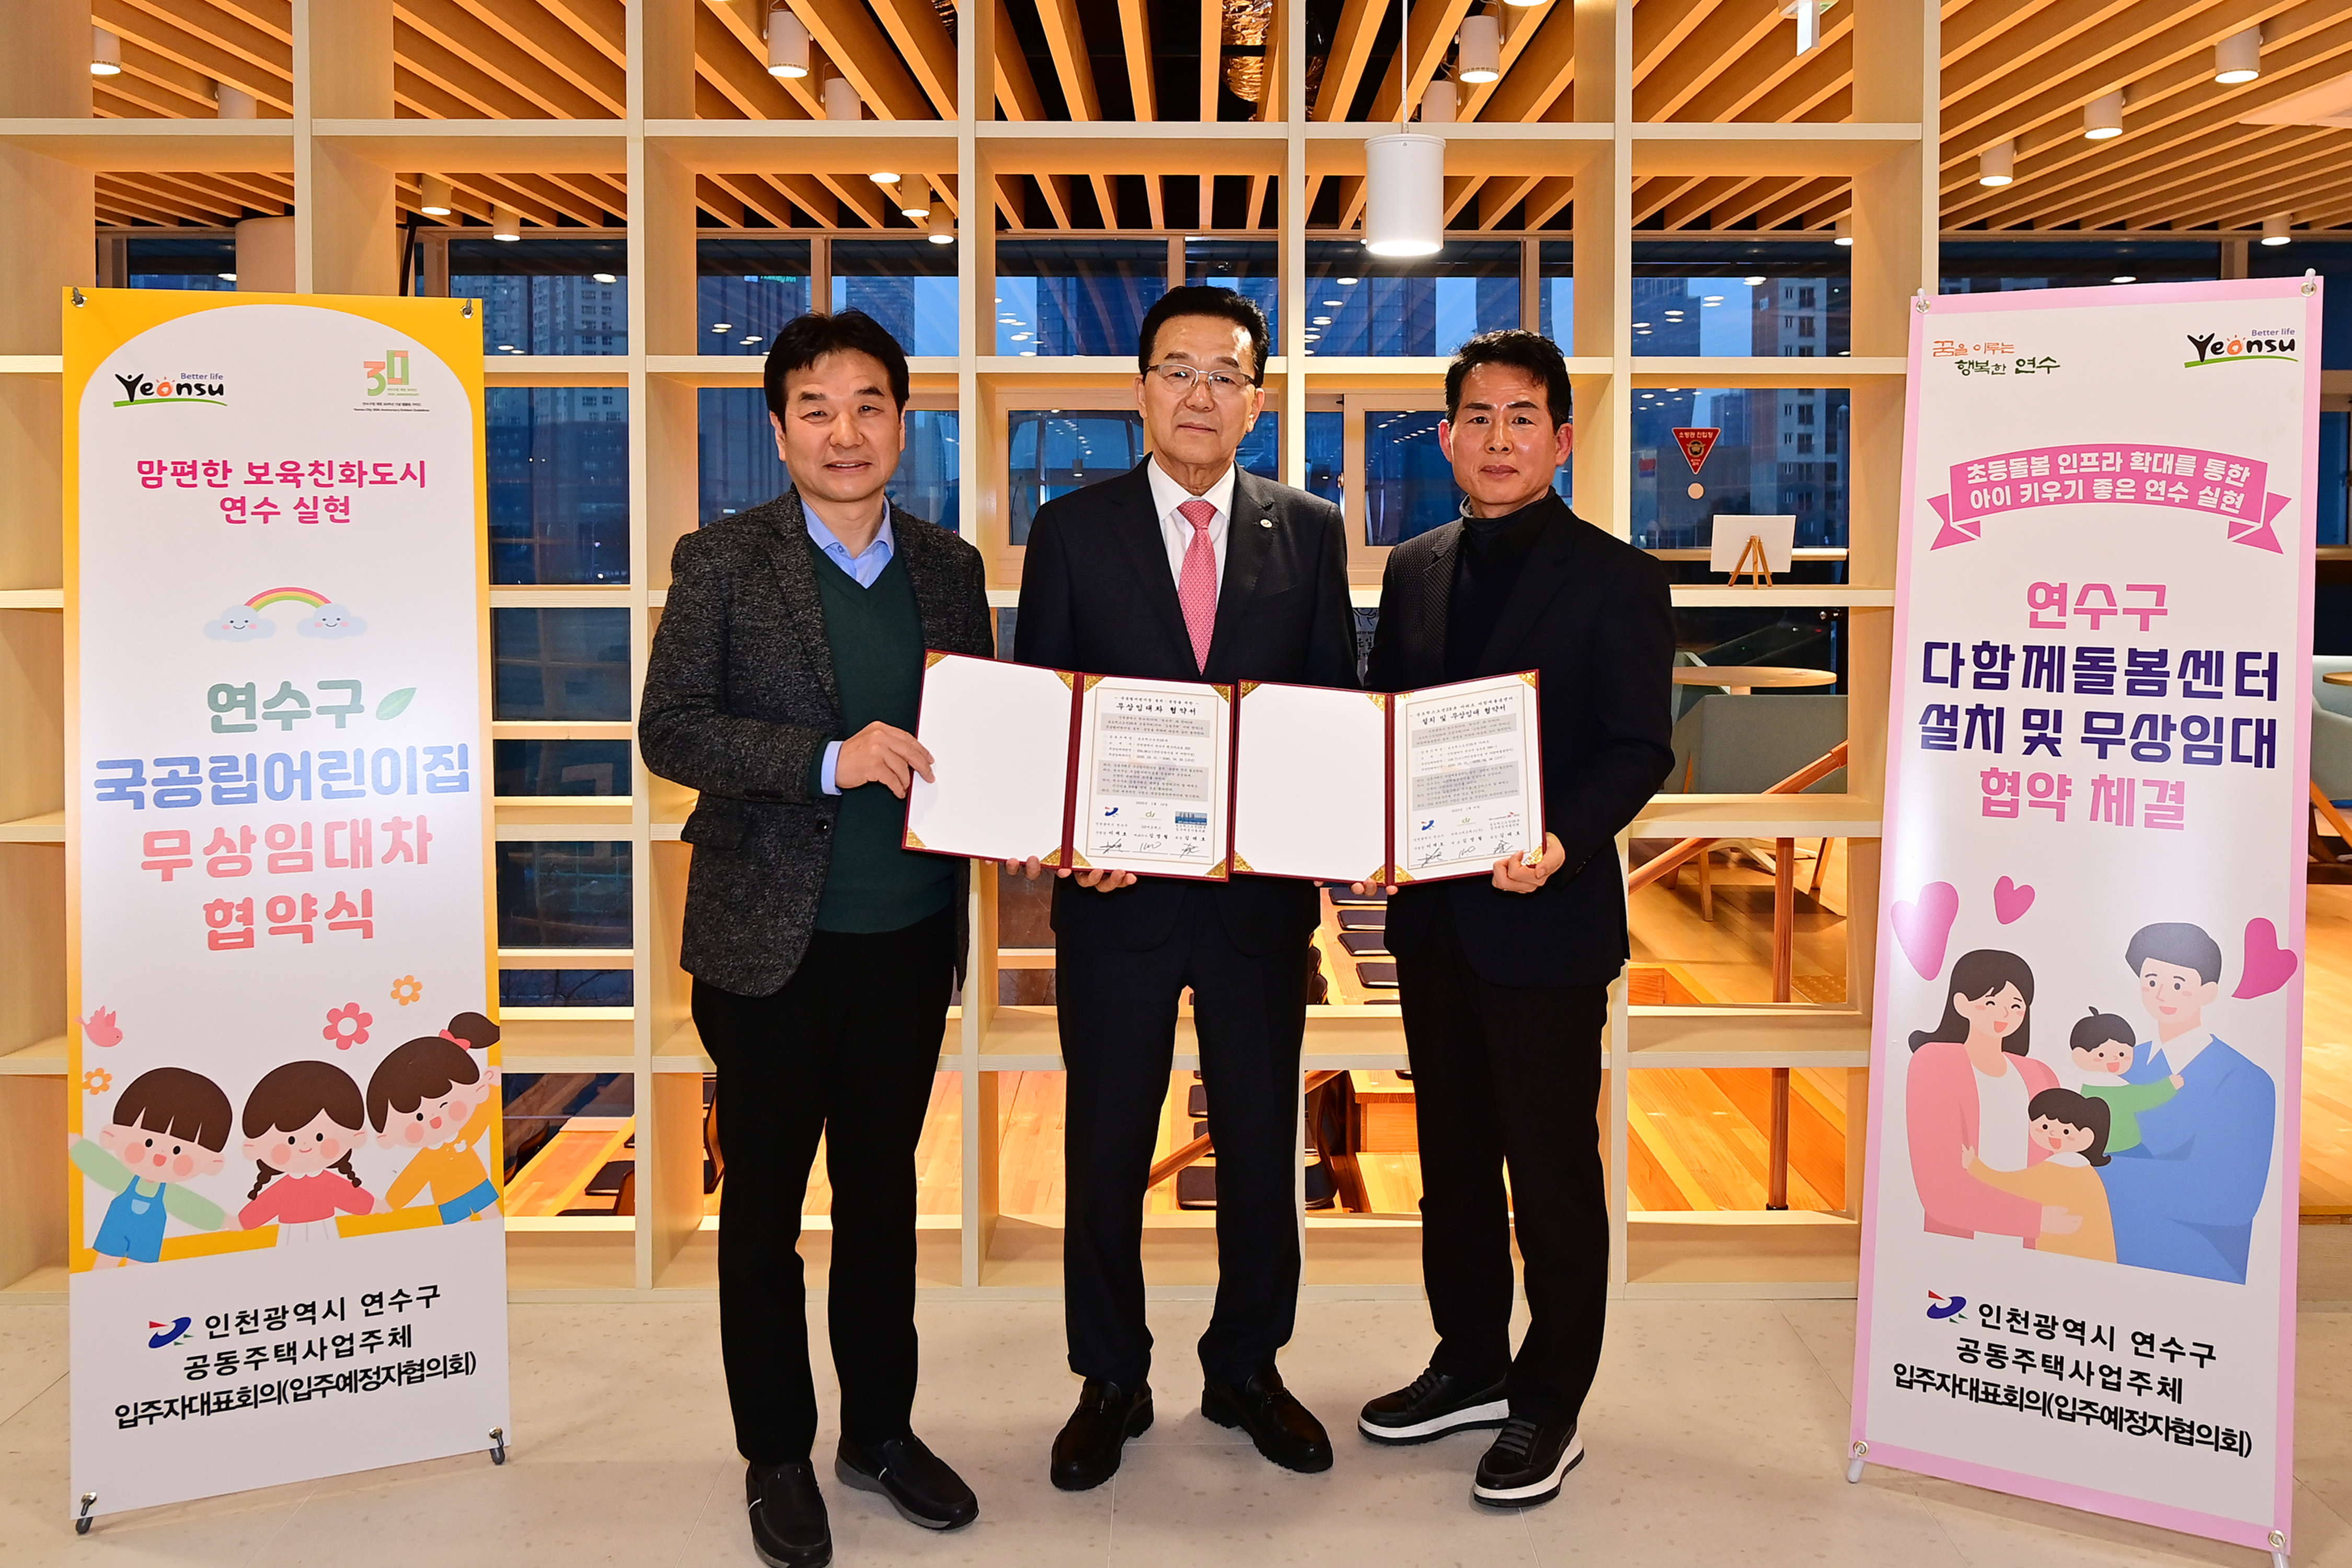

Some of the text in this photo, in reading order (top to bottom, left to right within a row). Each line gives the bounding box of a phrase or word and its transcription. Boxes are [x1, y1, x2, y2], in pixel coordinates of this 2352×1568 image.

[364, 350, 409, 396] 30
[1933, 340, 2014, 358] 꿈을 이루는
[1954, 356, 2060, 376] 행복한 연수
[2187, 332, 2296, 362] Yeonsu
[114, 373, 224, 402] Yeonsu
[137, 460, 426, 489] 맘편한 보육친화도시
[1967, 452, 2251, 488] 초등돌봄 인프라 확대를 통한
[1970, 478, 2245, 515] 아이 키우기 좋은 연수 실현
[220, 495, 350, 524] 연수 실현
[2027, 582, 2168, 631] 연수구
[1922, 640, 2278, 701] 다함께돌봄센터
[207, 679, 365, 733] 연수구
[1918, 703, 2276, 768] 설치 및 무상임대
[94, 743, 469, 810] 국공립어린이집
[1980, 767, 2186, 830] 협약 체결
[141, 815, 433, 882] 무상임대차
[203, 889, 373, 951] 협약식
[205, 1285, 441, 1339] 인천광역시 연수구
[1978, 1304, 2217, 1369] 인천광역시 연수구
[184, 1324, 412, 1381] 공동주택사업주체
[1956, 1337, 2183, 1404] 공동주택사업주체
[114, 1351, 477, 1429] 입주자대표회의(입주예정자협의회)
[1893, 1363, 2253, 1458] 입주자대표회의(입주예정자협의회)
